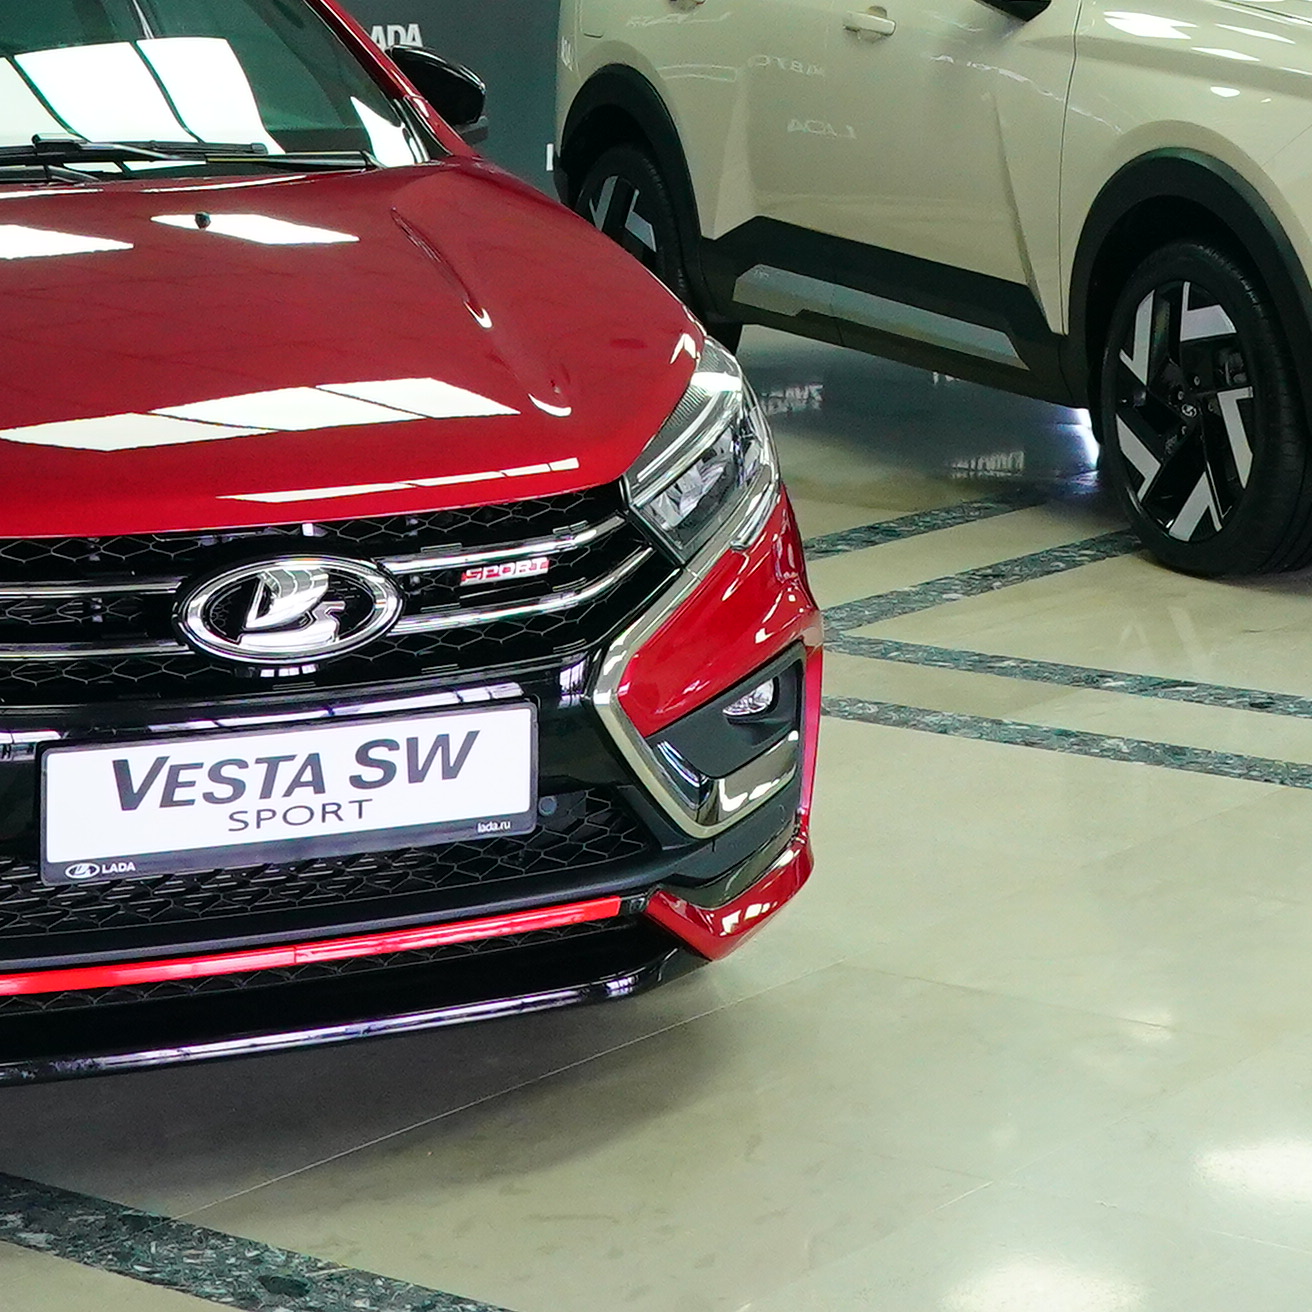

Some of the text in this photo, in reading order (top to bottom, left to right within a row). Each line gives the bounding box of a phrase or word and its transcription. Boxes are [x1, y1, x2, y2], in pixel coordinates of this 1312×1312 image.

[371, 24, 423, 50] ADA
[460, 557, 549, 585] SPORT
[112, 730, 480, 811] VESTA SW
[228, 798, 373, 831] SPORT
[477, 820, 512, 834] lada.ru
[101, 861, 136, 875] LADA
